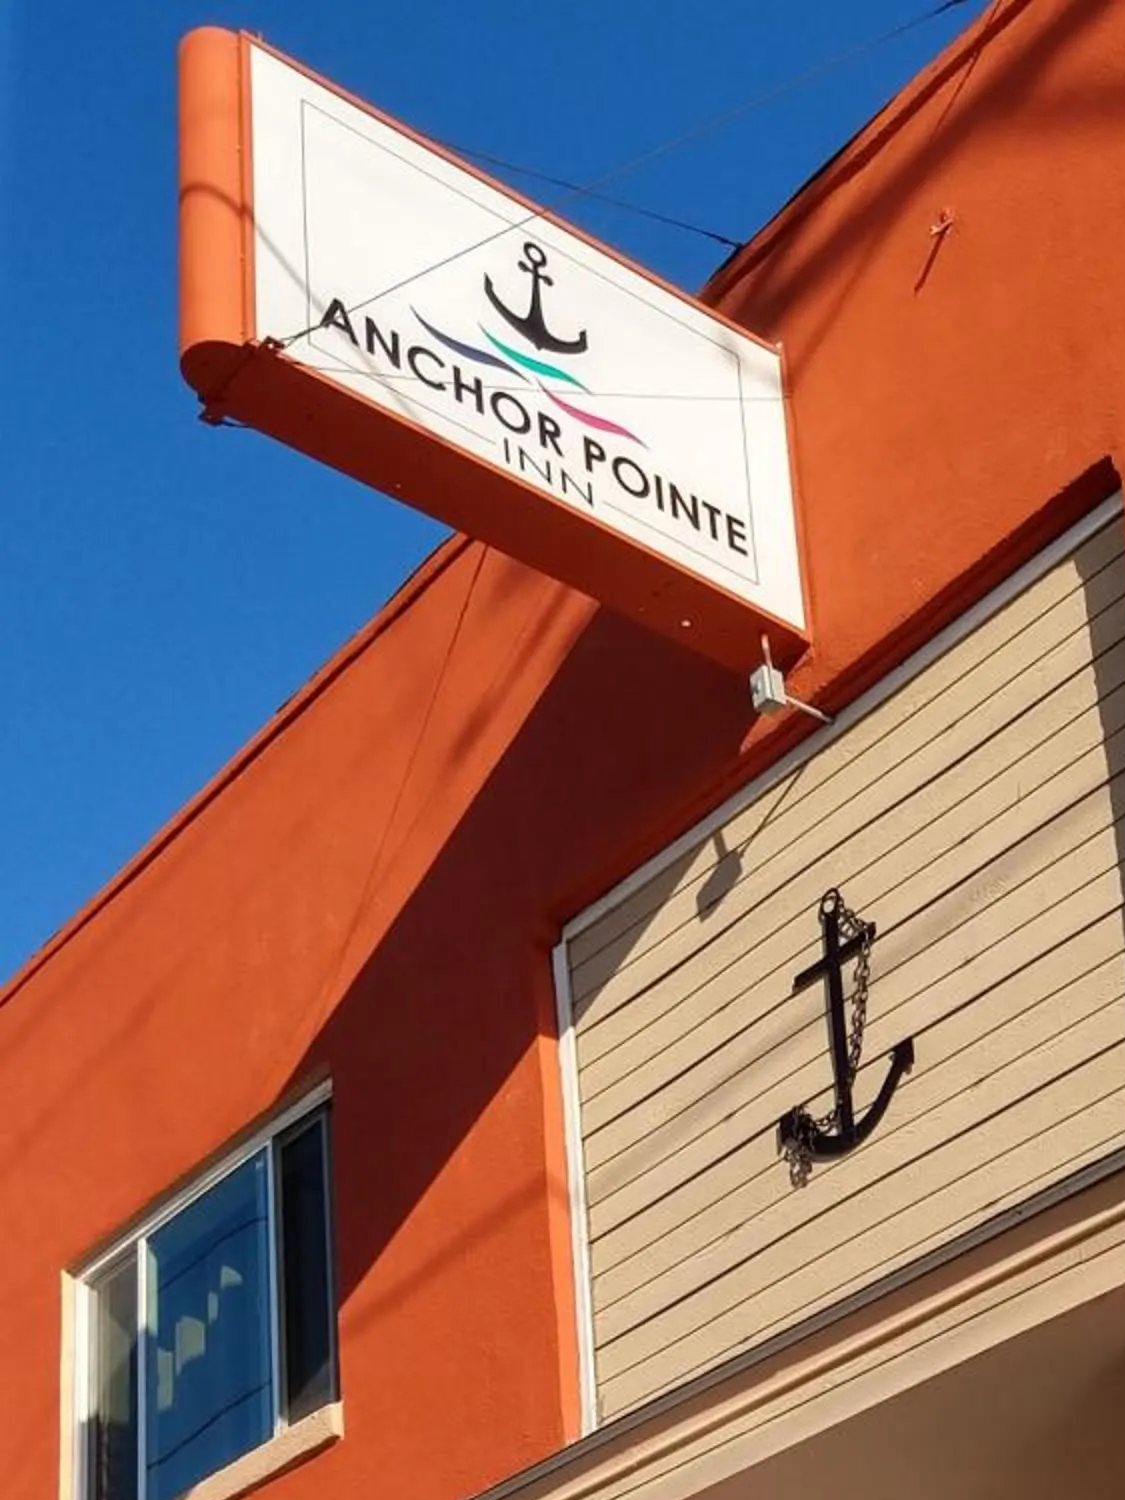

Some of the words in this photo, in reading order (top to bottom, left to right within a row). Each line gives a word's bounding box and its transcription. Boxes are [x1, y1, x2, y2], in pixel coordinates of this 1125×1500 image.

[321, 298, 564, 457] ANCHOR
[584, 437, 748, 557] POINTE
[503, 437, 594, 508] INN
